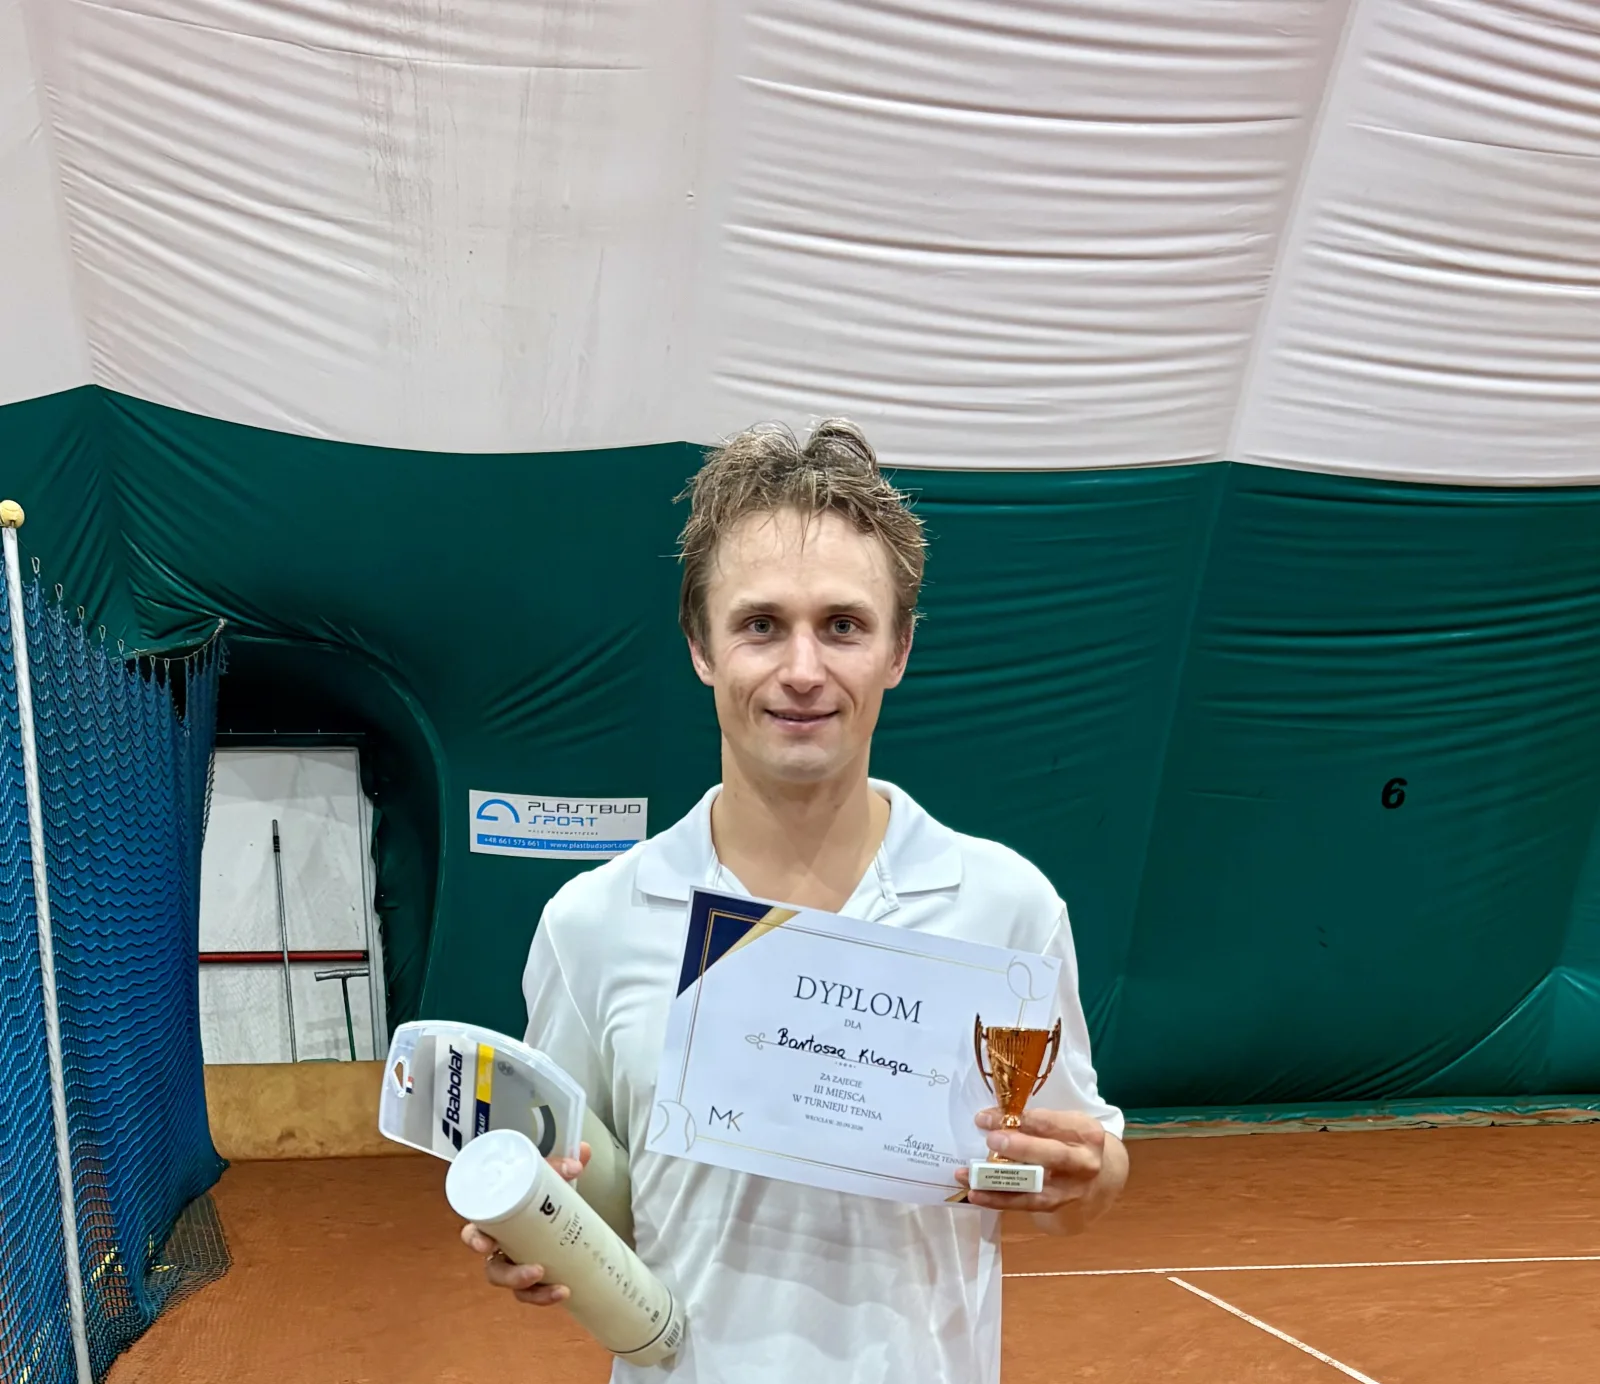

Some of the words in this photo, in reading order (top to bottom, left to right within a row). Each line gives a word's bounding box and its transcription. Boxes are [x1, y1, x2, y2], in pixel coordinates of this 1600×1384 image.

[1381, 777, 1408, 809] 6
[528, 801, 641, 814] PLASTBUD
[528, 815, 599, 827] SPORT
[498, 837, 511, 845] 661
[527, 839, 540, 847] 661
[793, 975, 923, 1024] DYPLOM
[844, 1018, 862, 1030] DLA
[858, 1048, 912, 1076] Klaga
[446, 1044, 463, 1124] Babolat
[820, 1072, 831, 1081] ZA
[813, 1084, 824, 1095] III
[825, 1086, 866, 1104] MIEJSCA
[792, 1093, 802, 1103] W
[804, 1095, 848, 1113] TURNIEJU
[850, 1106, 882, 1121] TENISA
[913, 1150, 940, 1161] KAPUSZ
